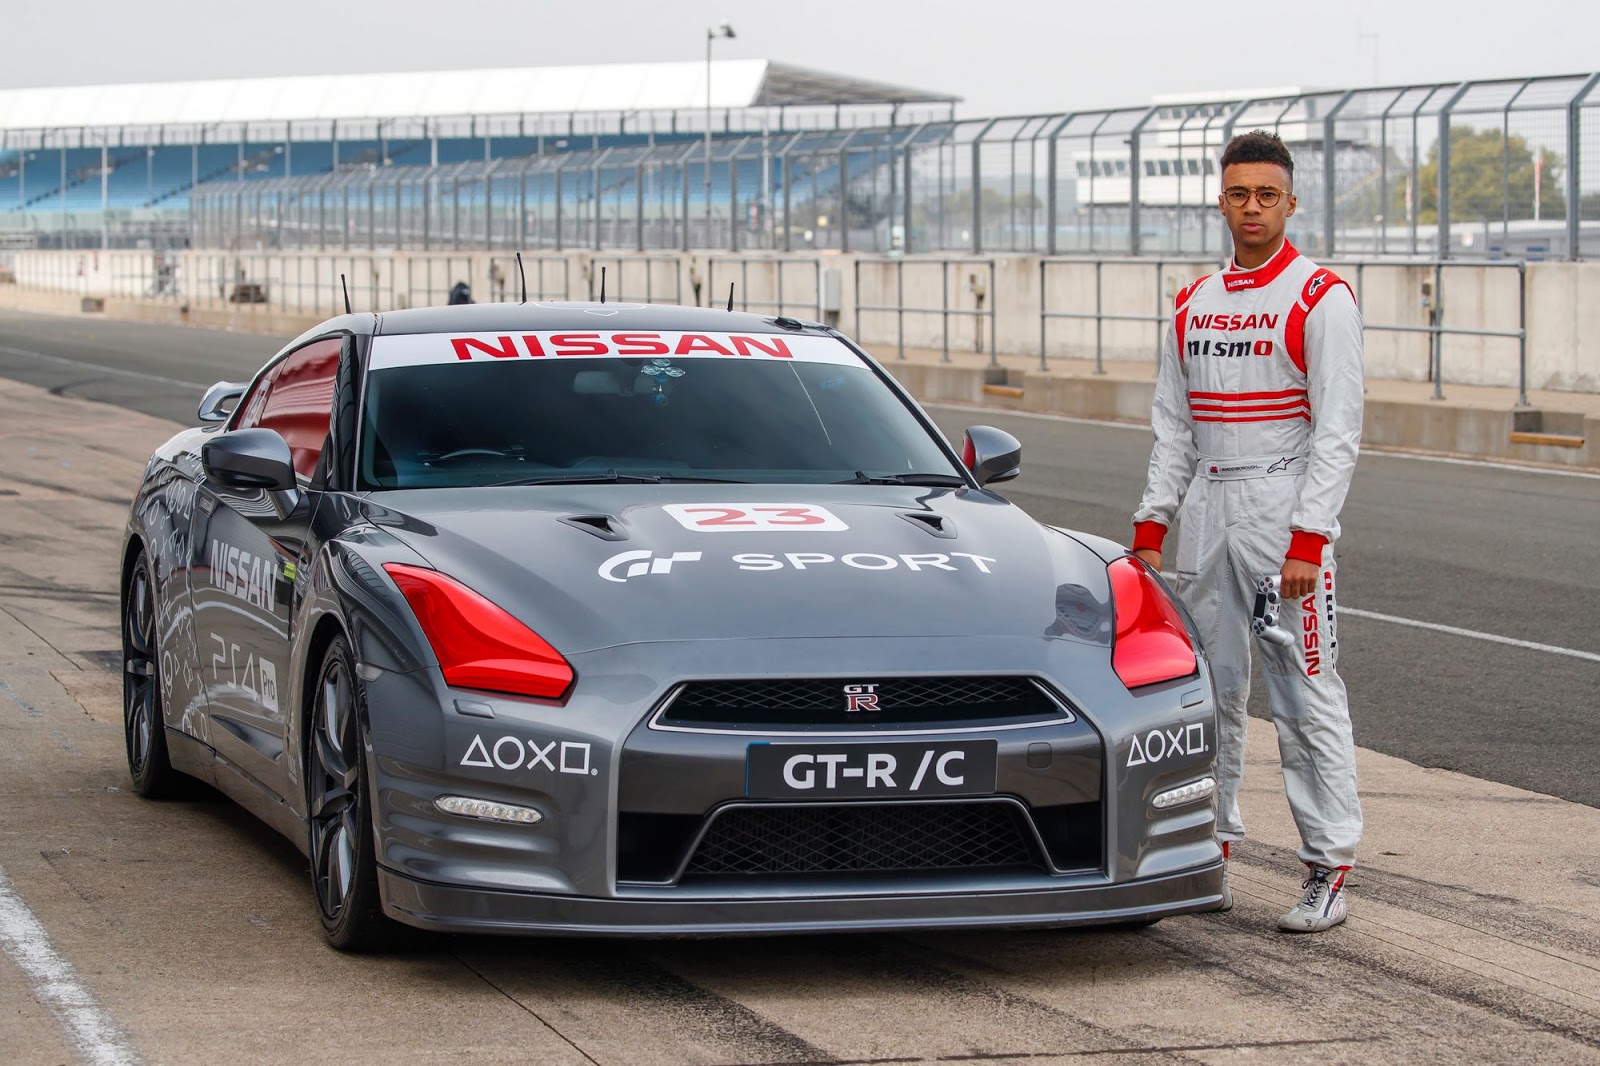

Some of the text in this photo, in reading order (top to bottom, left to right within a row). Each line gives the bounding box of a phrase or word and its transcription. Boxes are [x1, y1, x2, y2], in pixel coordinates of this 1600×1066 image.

[1227, 278, 1255, 288] NISSAN
[1190, 313, 1279, 331] NISSAN
[451, 333, 793, 360] NISSAN
[1187, 340, 1273, 357] nismo
[684, 507, 826, 525] 23
[731, 552, 998, 574] SPORT
[210, 539, 278, 611] NISSAN
[1302, 594, 1320, 676] NISSA
[262, 669, 275, 700] Pro
[844, 684, 879, 693] GT
[846, 694, 881, 711] R
[783, 750, 965, 790] GT-R /C
